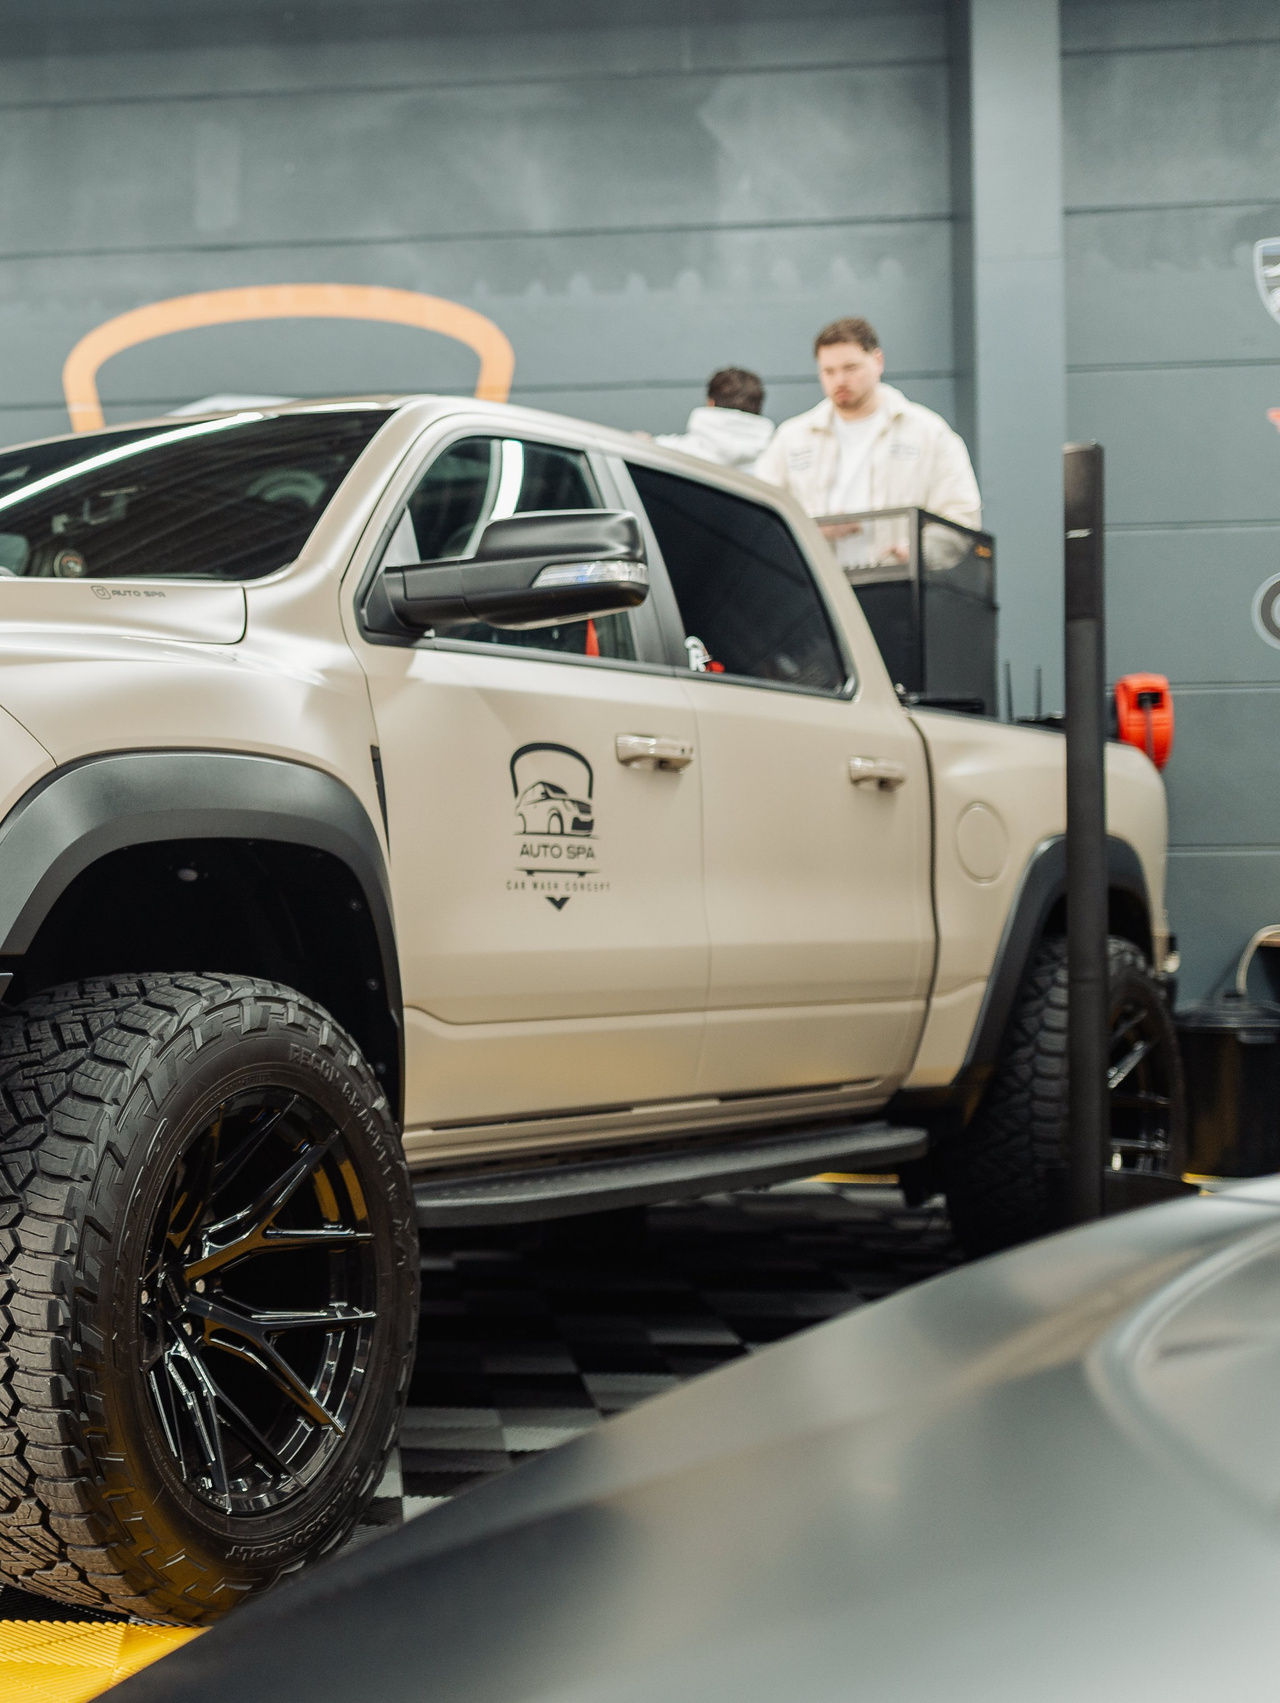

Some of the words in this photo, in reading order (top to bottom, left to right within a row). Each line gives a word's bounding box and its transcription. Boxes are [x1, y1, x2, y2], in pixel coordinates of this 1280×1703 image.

[520, 844, 563, 859] AUTO
[566, 845, 596, 860] SPA
[506, 880, 526, 891] CAR
[532, 881, 559, 892] WASH
